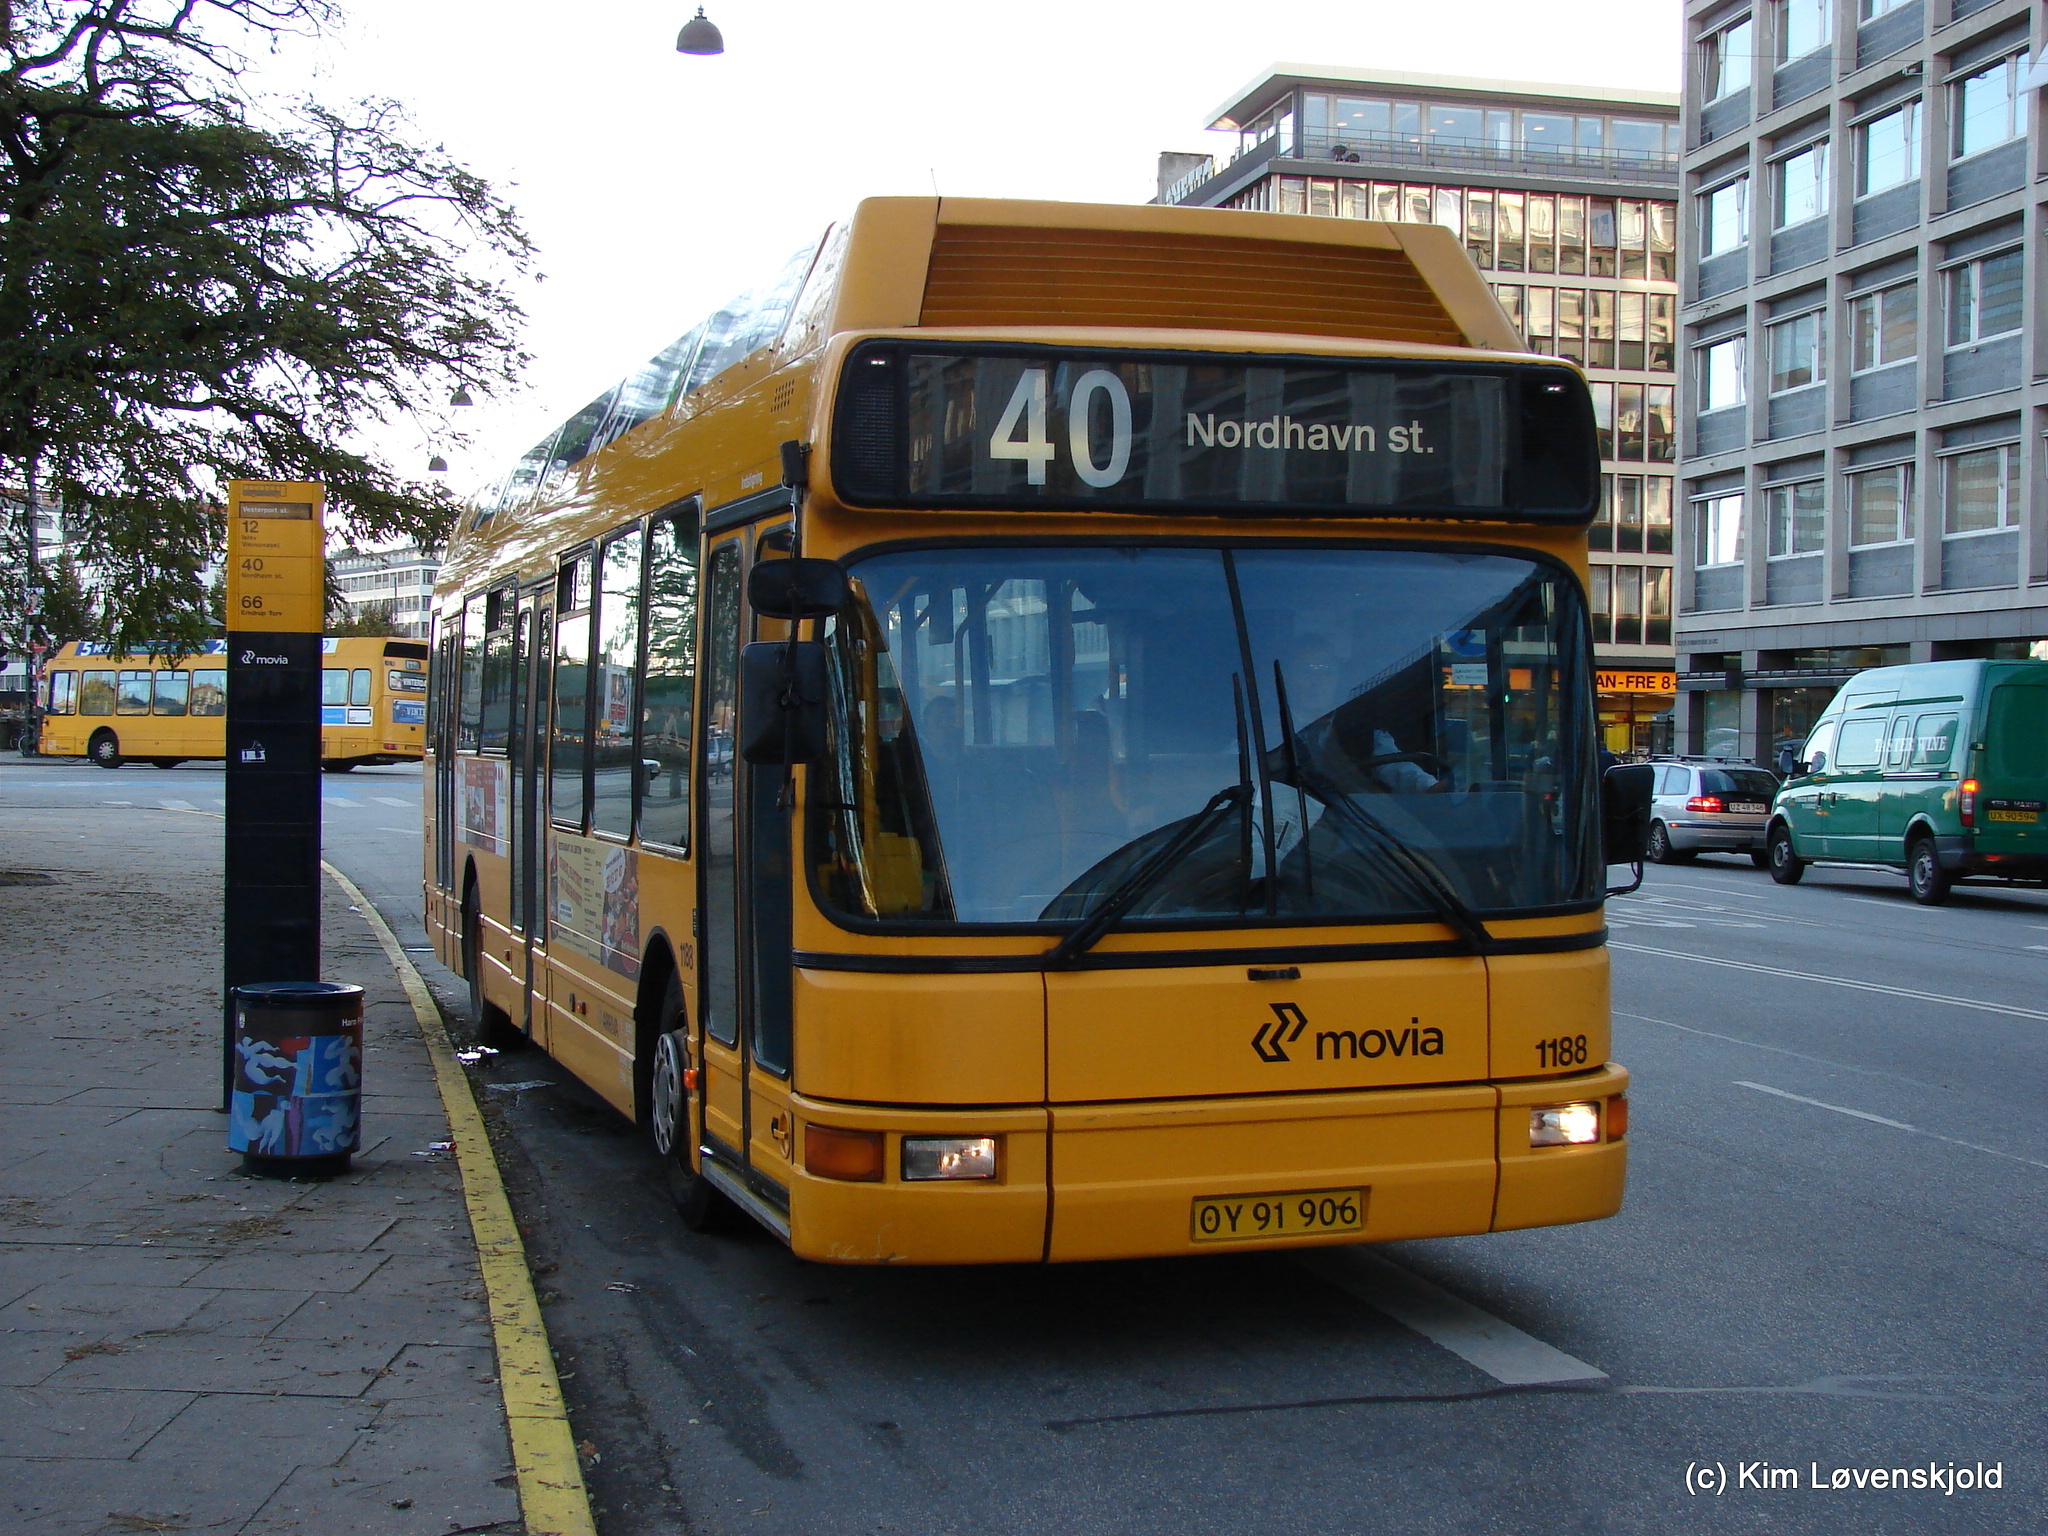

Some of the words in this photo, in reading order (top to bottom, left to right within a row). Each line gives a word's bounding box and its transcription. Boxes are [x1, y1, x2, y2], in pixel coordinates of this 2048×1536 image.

[990, 368, 1133, 488] 40
[1187, 412, 1376, 452] Nordhavn
[1387, 420, 1434, 454] st.
[241, 520, 259, 533] 12
[241, 558, 264, 571] 40
[241, 595, 263, 609] 66
[80, 641, 93, 656] 5
[256, 655, 289, 665] movia
[1918, 736, 1947, 751] WINE
[1990, 811, 2003, 820] UX
[2005, 812, 2017, 820] 90
[1316, 1016, 1444, 1061] movia
[1535, 1034, 1588, 1068] 1188
[1199, 1203, 1244, 1235] OY
[1252, 1201, 1284, 1231] 91
[1297, 1196, 1358, 1228] 906
